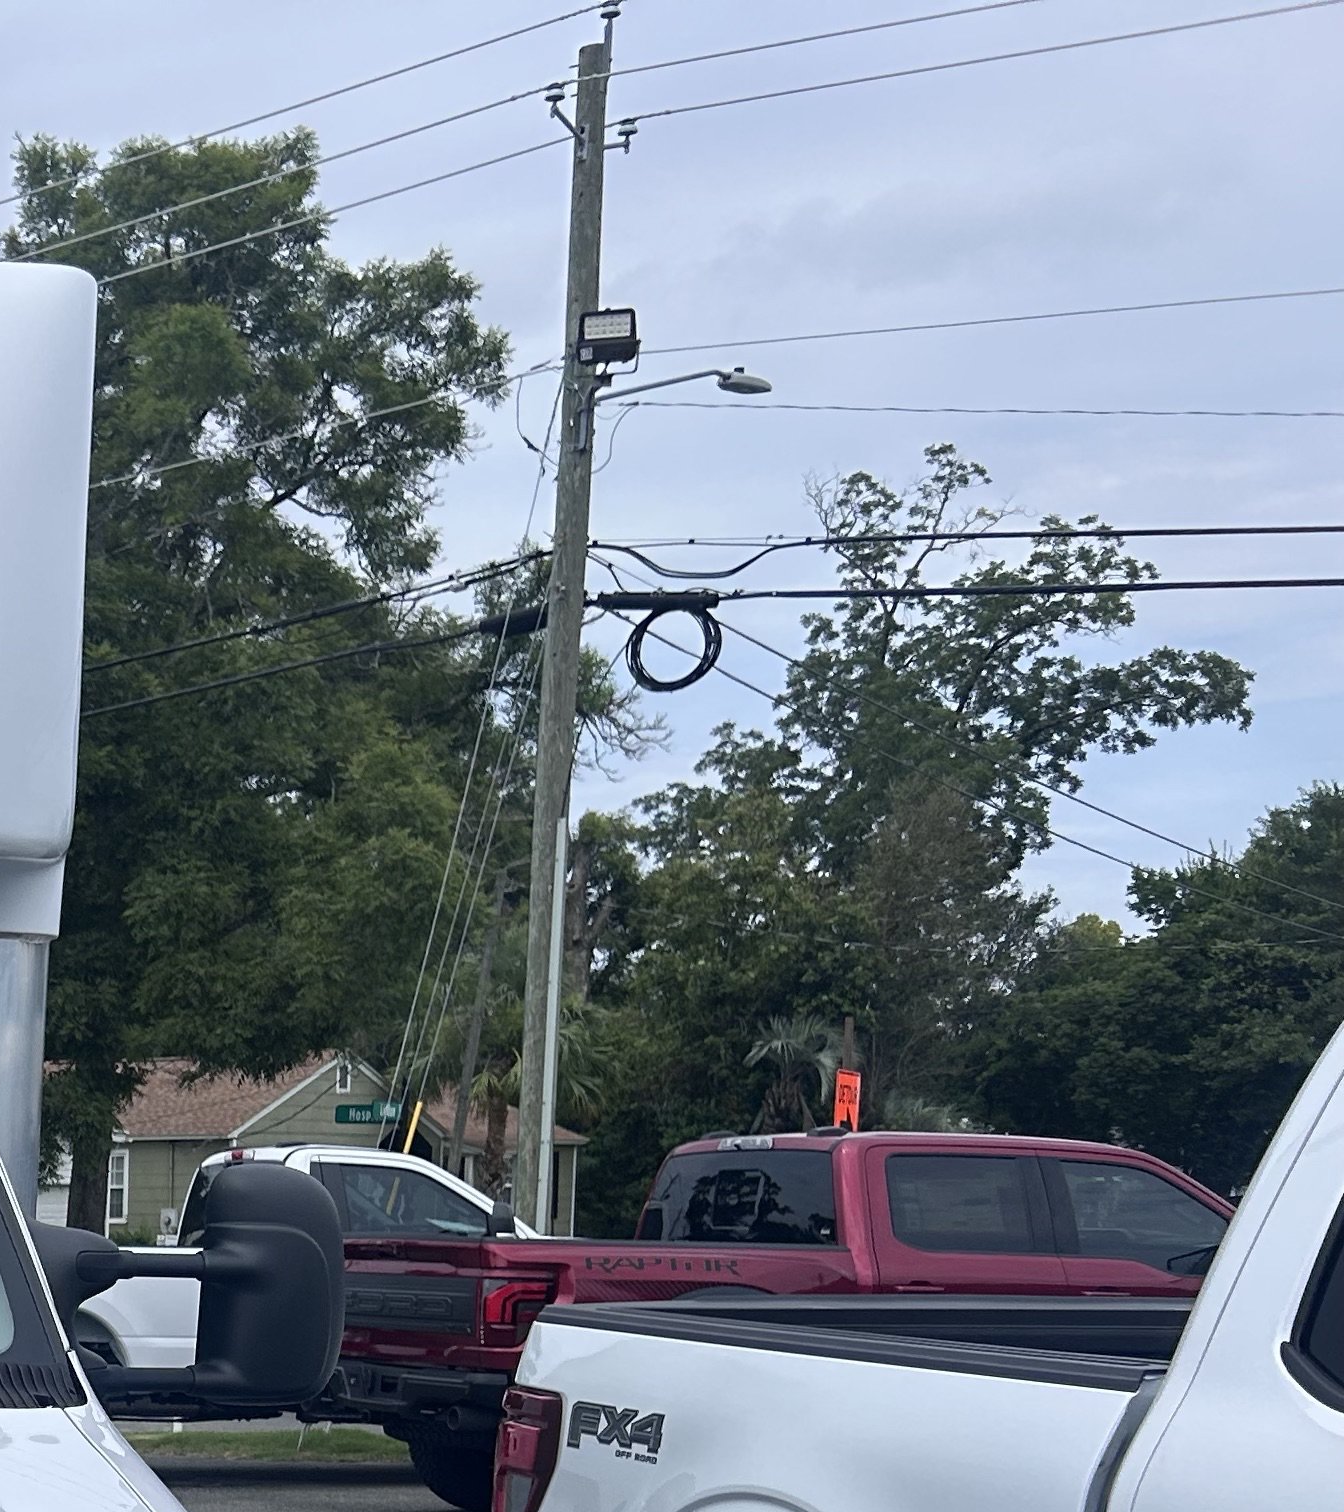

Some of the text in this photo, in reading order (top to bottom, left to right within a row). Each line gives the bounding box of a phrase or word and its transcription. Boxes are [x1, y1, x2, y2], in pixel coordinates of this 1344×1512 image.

[584, 1255, 743, 1278] RAPTOR
[566, 1400, 666, 1454] FX4
[614, 1449, 658, 1465] OFF ROAD
